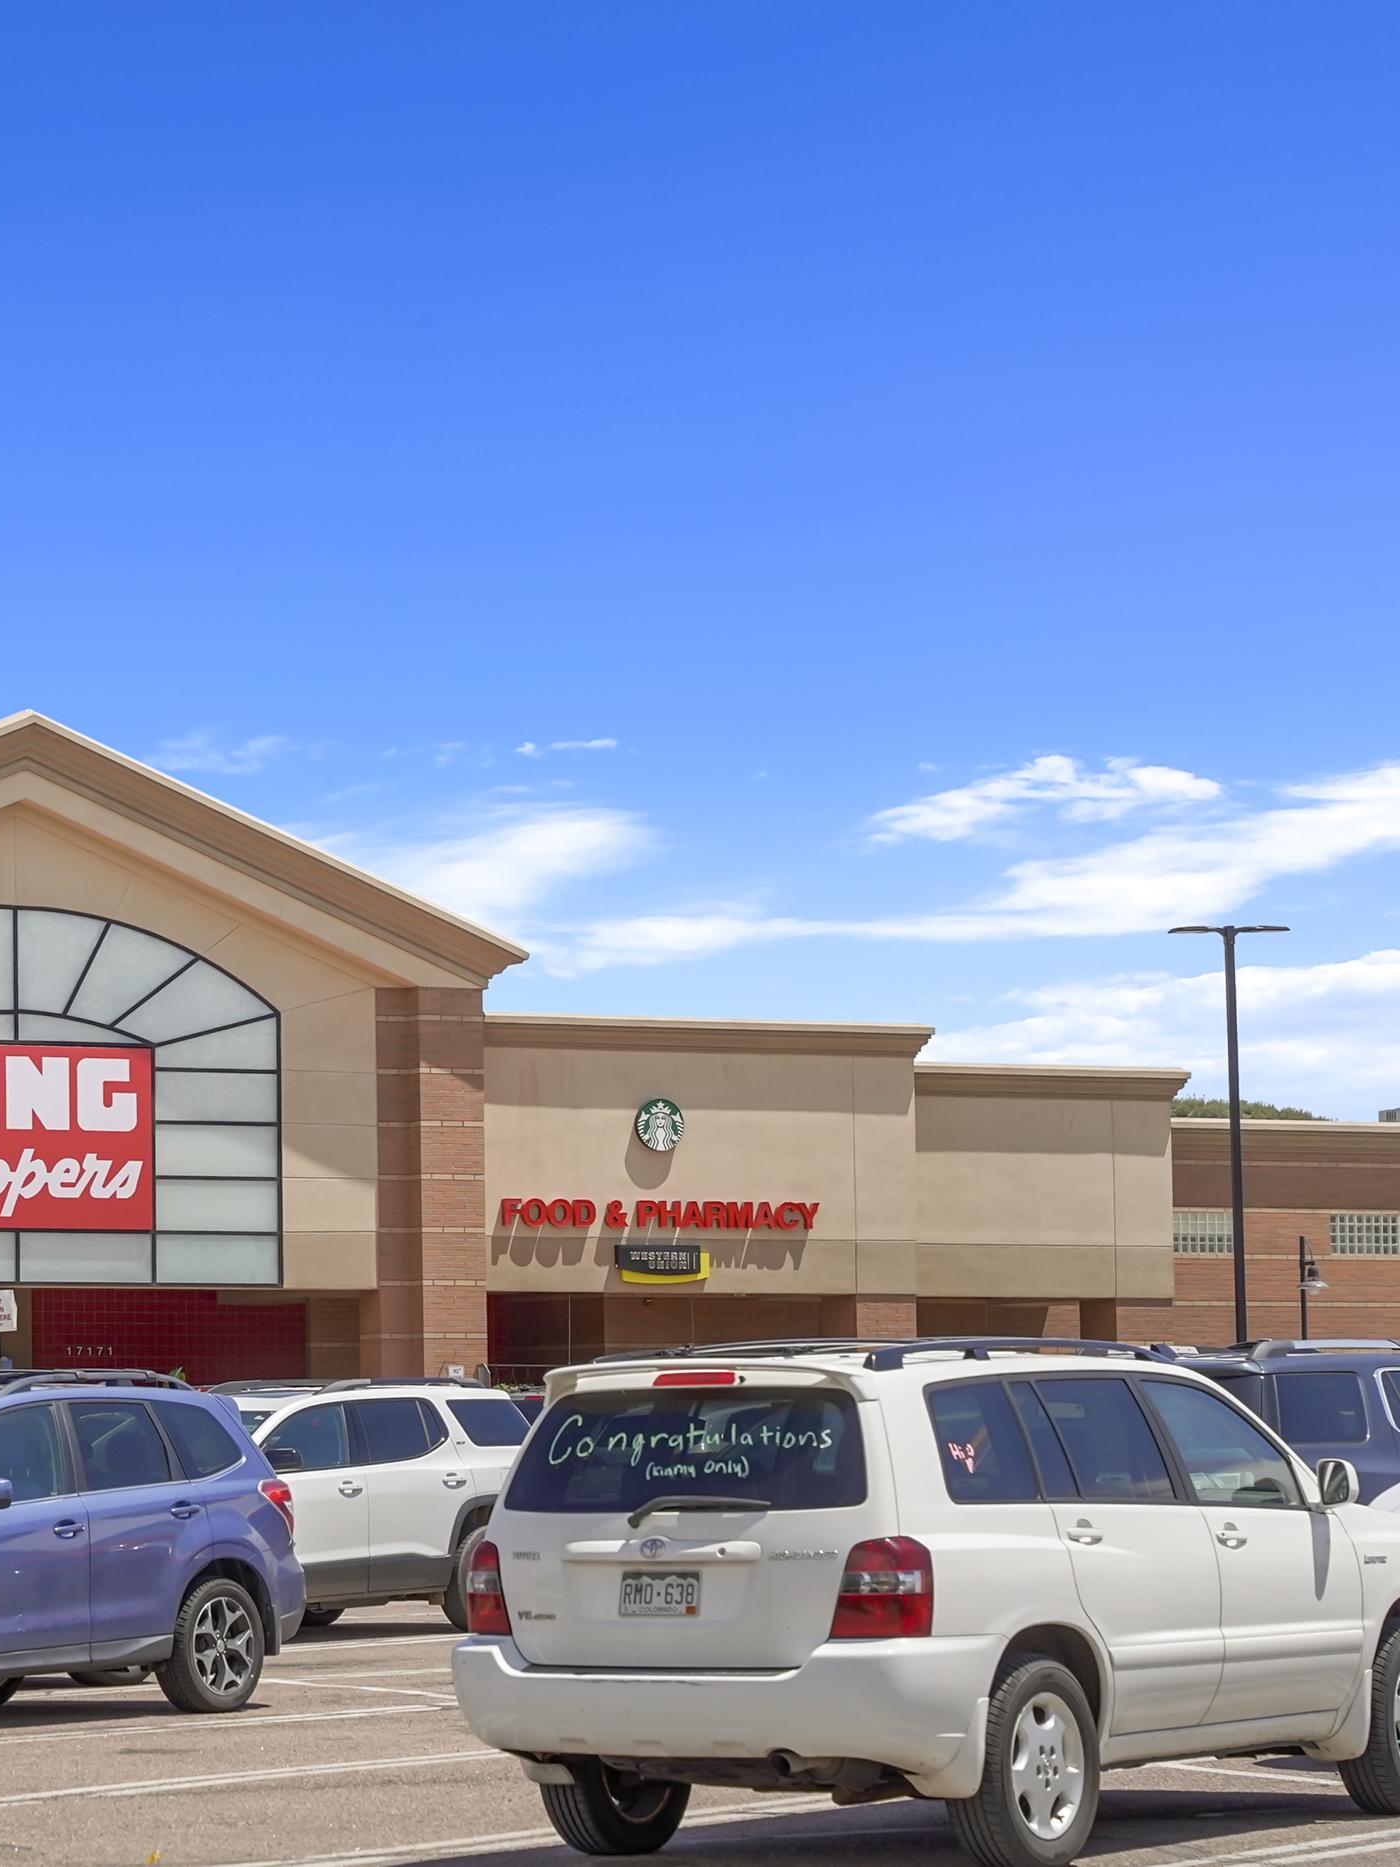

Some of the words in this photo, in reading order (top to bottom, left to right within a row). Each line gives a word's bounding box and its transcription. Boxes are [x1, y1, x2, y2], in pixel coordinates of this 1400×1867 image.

[501, 1198, 596, 1228] FOOD
[604, 1200, 628, 1228] &
[636, 1200, 820, 1230] PHARMACY
[630, 1251, 687, 1261] WESTERN
[648, 1260, 687, 1270] UNION
[66, 1346, 113, 1356] 17171
[549, 1414, 833, 1467] Congratulations
